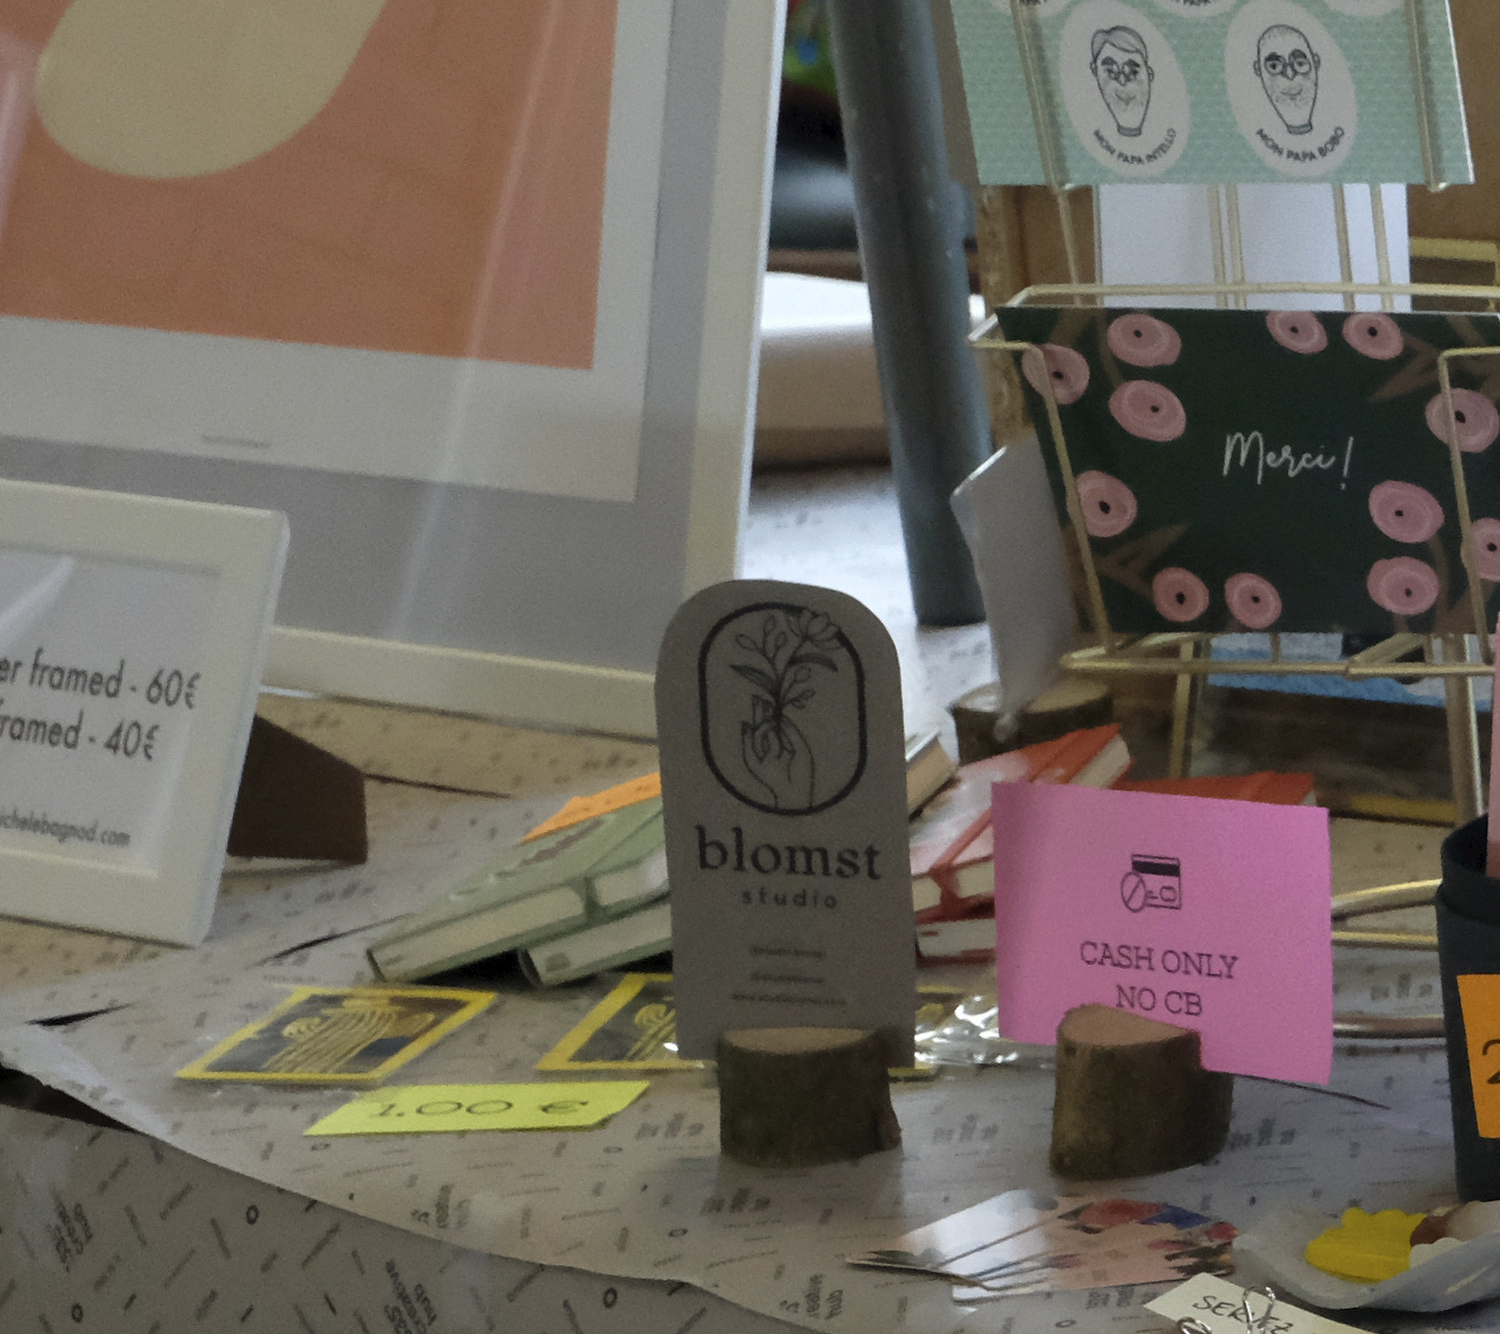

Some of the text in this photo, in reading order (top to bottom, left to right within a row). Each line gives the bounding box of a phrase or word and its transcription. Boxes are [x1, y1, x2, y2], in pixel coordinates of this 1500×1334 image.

[1094, 130, 1116, 156] MON
[1117, 151, 1145, 165] PAPA
[1256, 126, 1345, 162] MON PAPA BOBO
[28, 647, 125, 698] framed
[145, 668, 201, 709] 60€
[104, 720, 160, 761] 40€
[695, 824, 882, 880] blomst
[742, 887, 838, 910] studio
[1080, 940, 1239, 979] CASH ONLY
[1116, 984, 1203, 1016] NO CB
